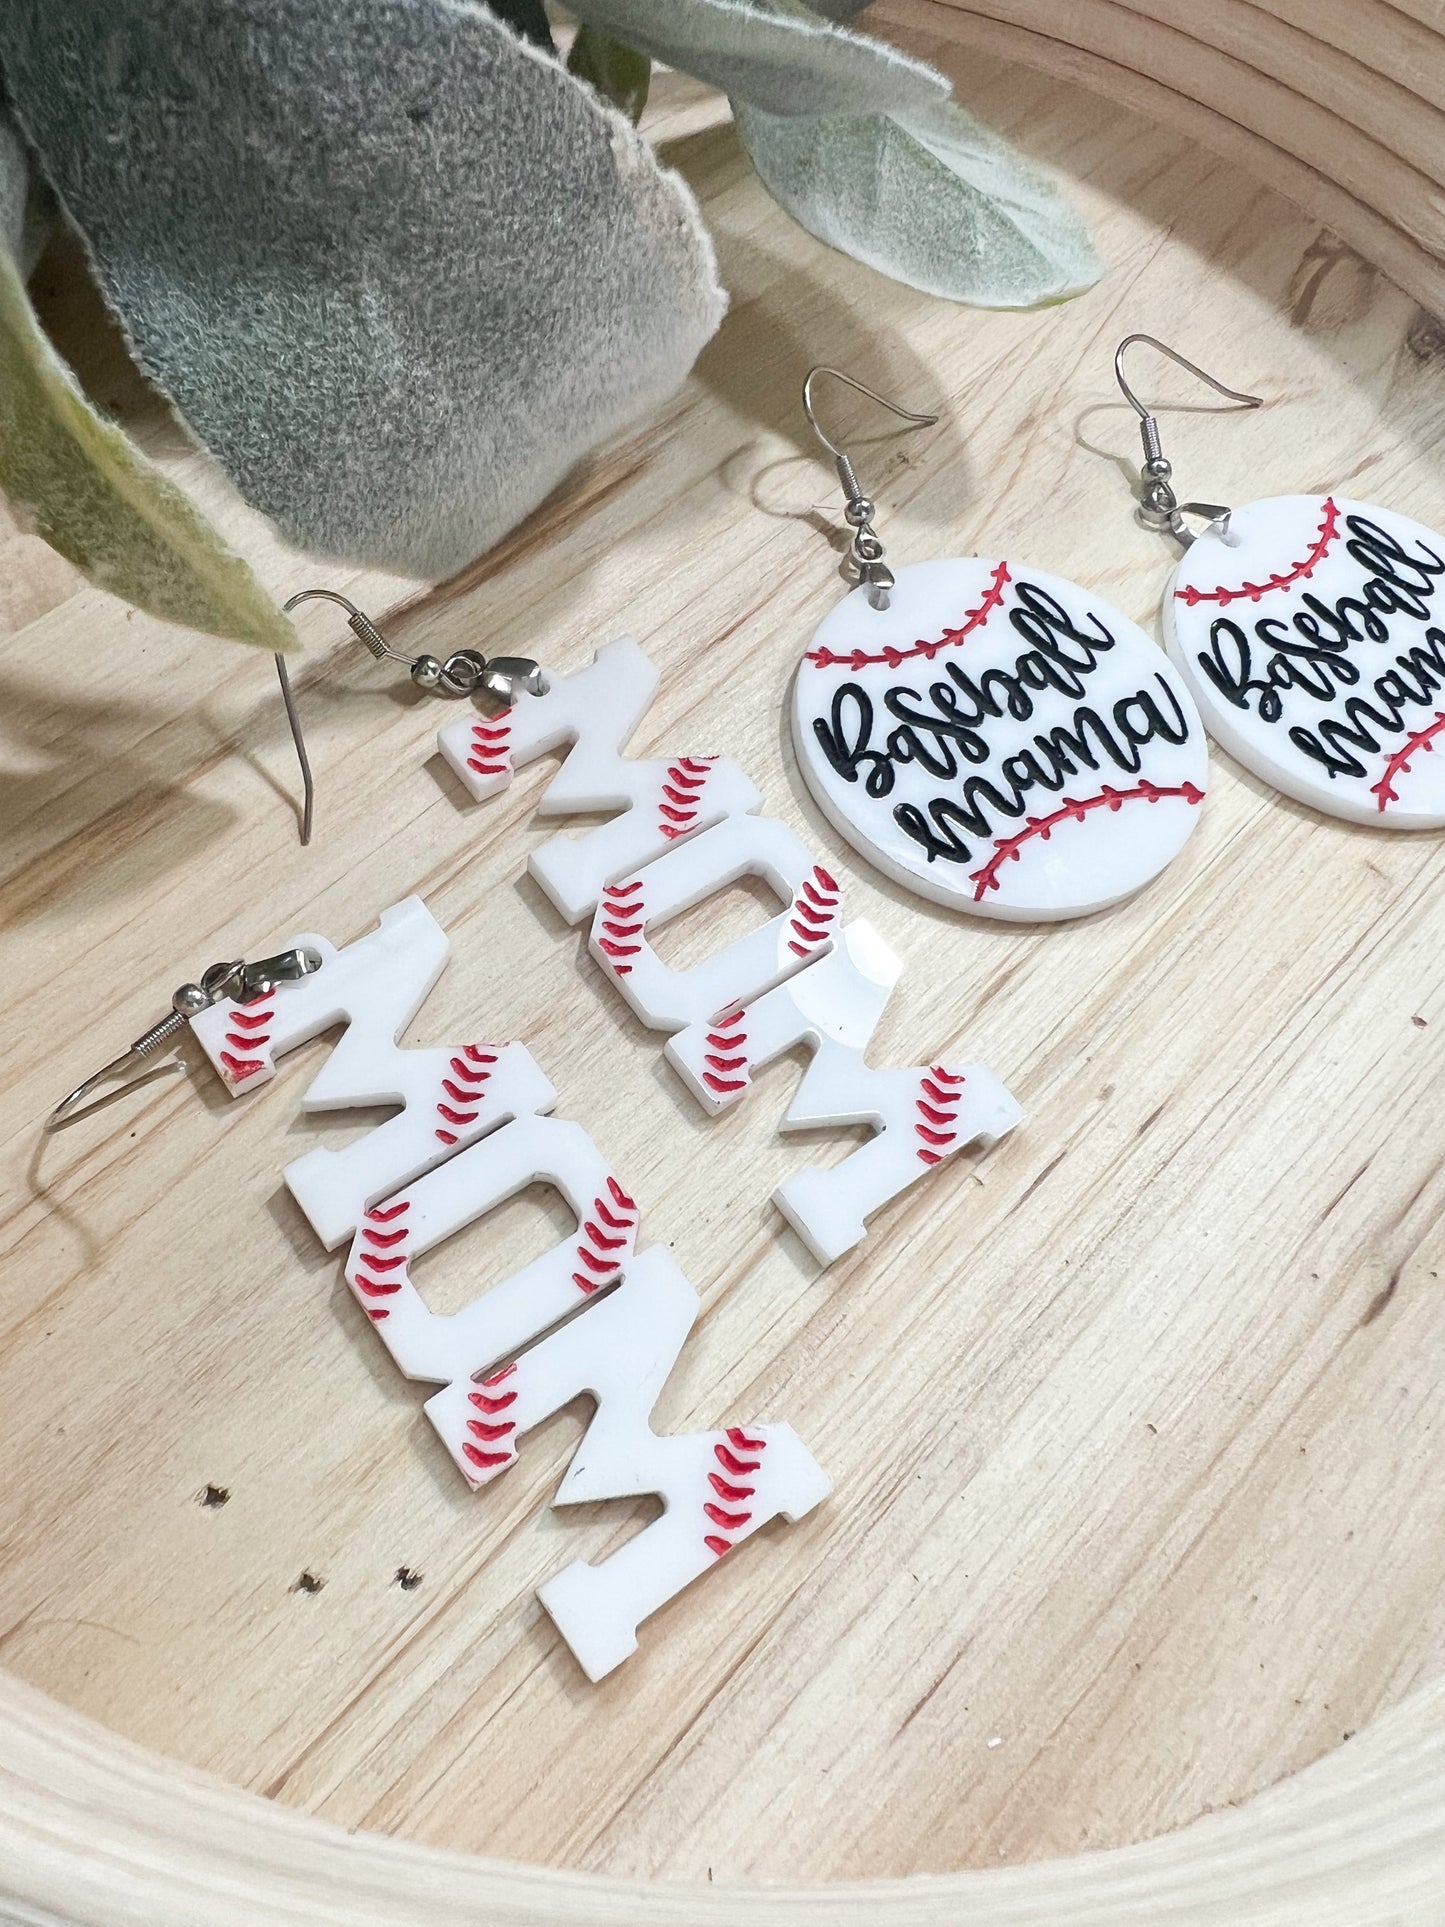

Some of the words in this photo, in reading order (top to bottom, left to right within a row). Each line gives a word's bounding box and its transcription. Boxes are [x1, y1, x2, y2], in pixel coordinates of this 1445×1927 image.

[813, 581, 1116, 799] Baseball
[1197, 514, 1445, 723] Baseball
[892, 672, 1189, 864] mama
[437, 634, 1028, 1268] MOM
[189, 893, 832, 1682] MOM
